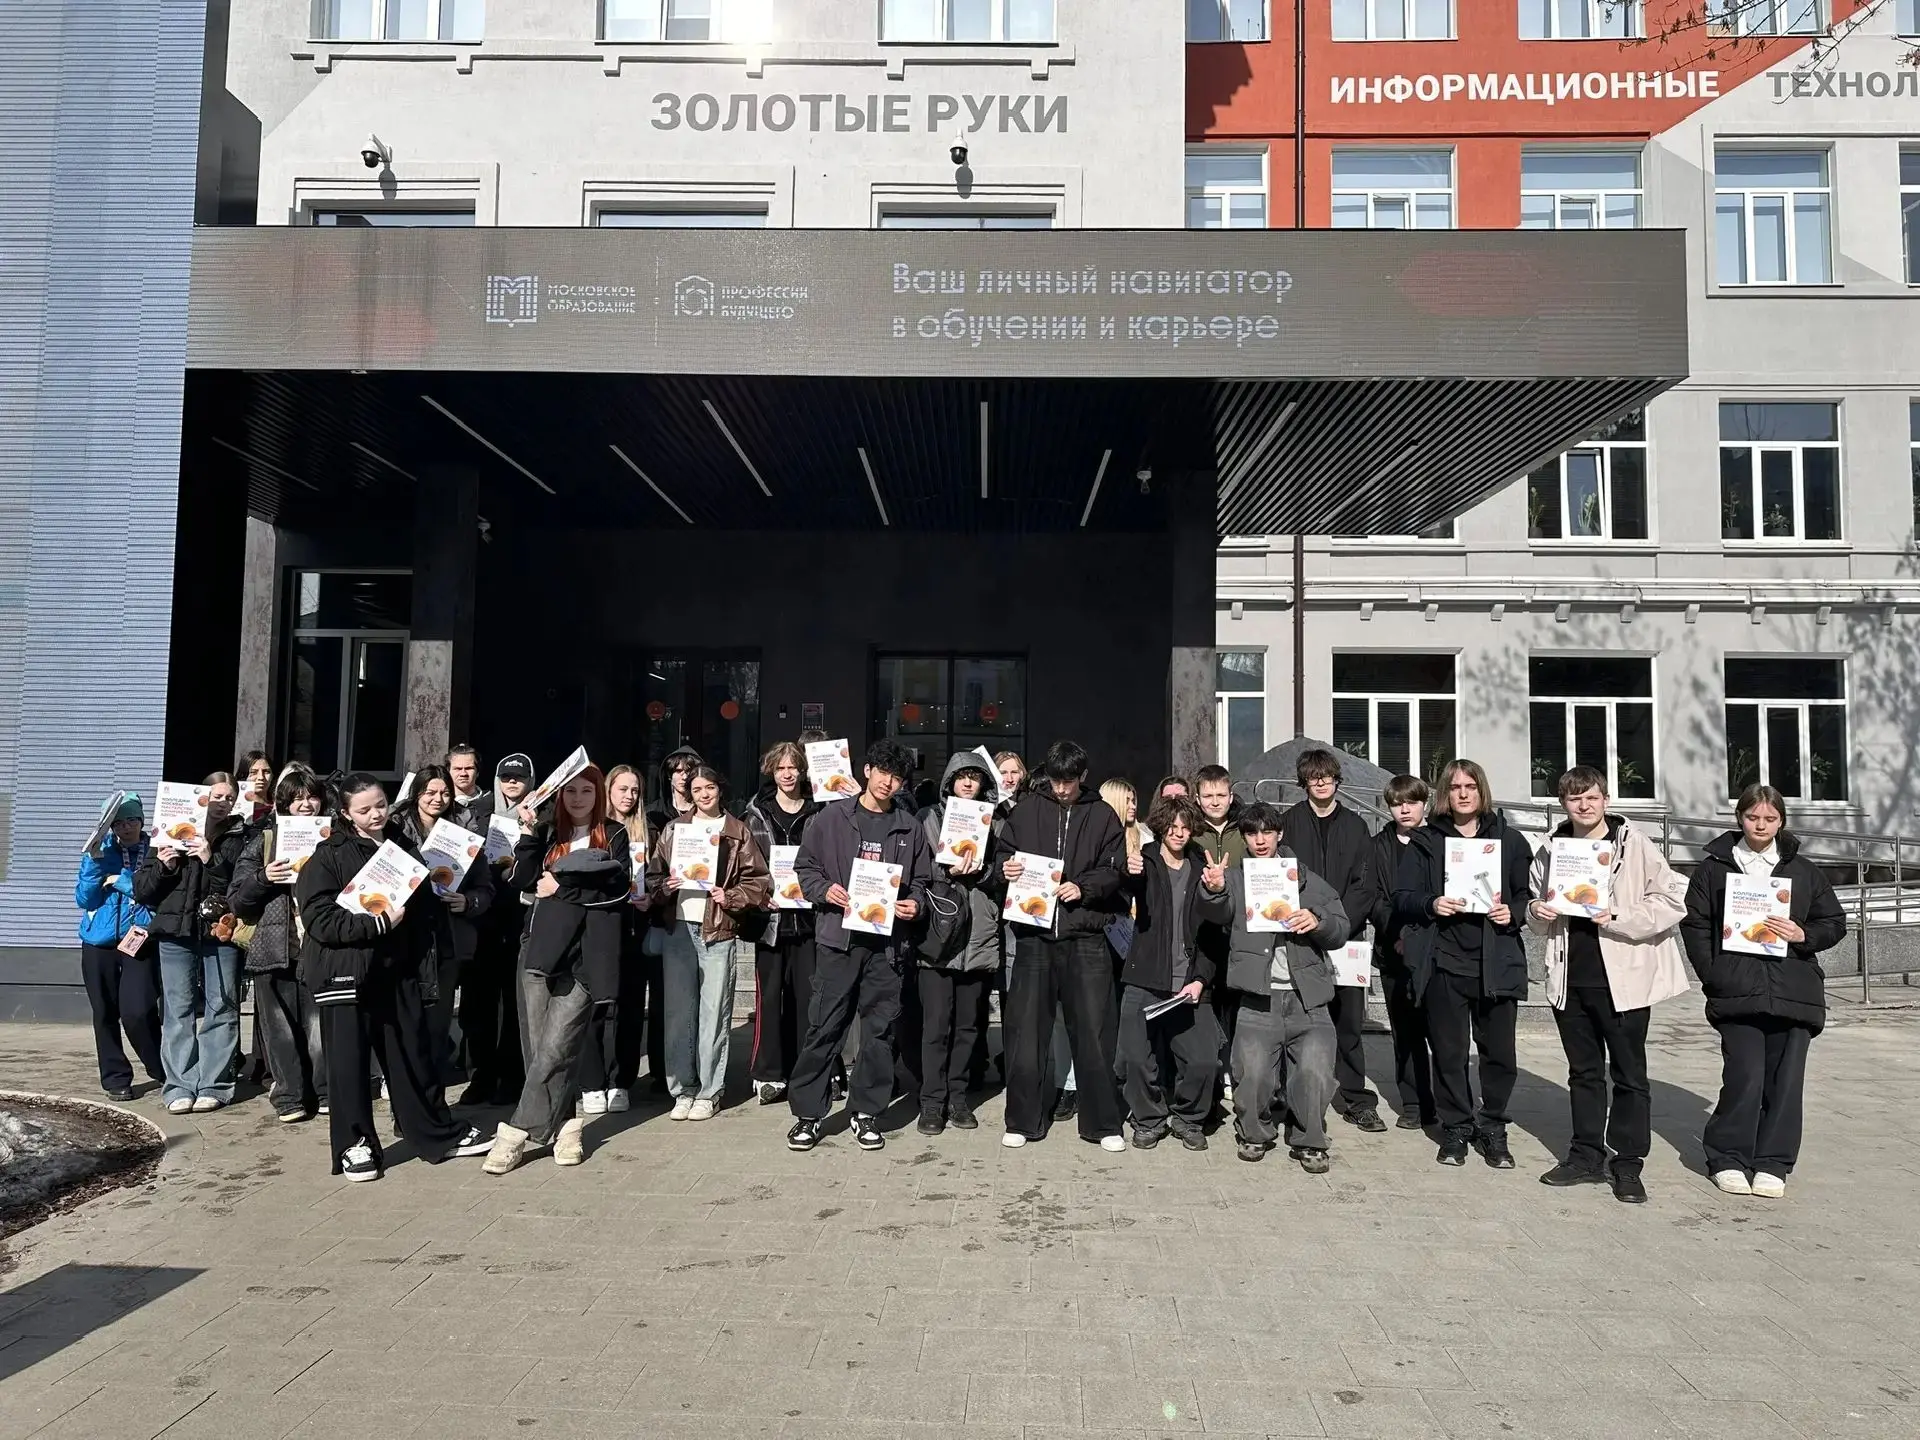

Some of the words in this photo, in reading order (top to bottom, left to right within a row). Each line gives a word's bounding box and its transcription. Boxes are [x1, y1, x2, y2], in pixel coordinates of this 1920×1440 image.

[1330, 70, 1719, 105] ИНФОРМАЦИОННЫЕ
[1766, 71, 1919, 98] ТЕХНОЛ
[650, 93, 911, 133] ЗОЛОТЫЕ
[928, 94, 1068, 133] РУКИ
[547, 284, 636, 297] МОСКОВСКОЕ
[721, 285, 808, 300] ПРОФЕССИИ
[893, 262, 965, 294] Ваш
[976, 264, 1098, 295] личный
[1110, 269, 1293, 303] навигатор
[547, 299, 636, 313] ОБРАЗОВАНИЕ
[893, 315, 906, 339] в
[917, 308, 1087, 348] обучении
[1100, 315, 1115, 339] и
[1128, 315, 1279, 348] карьере
